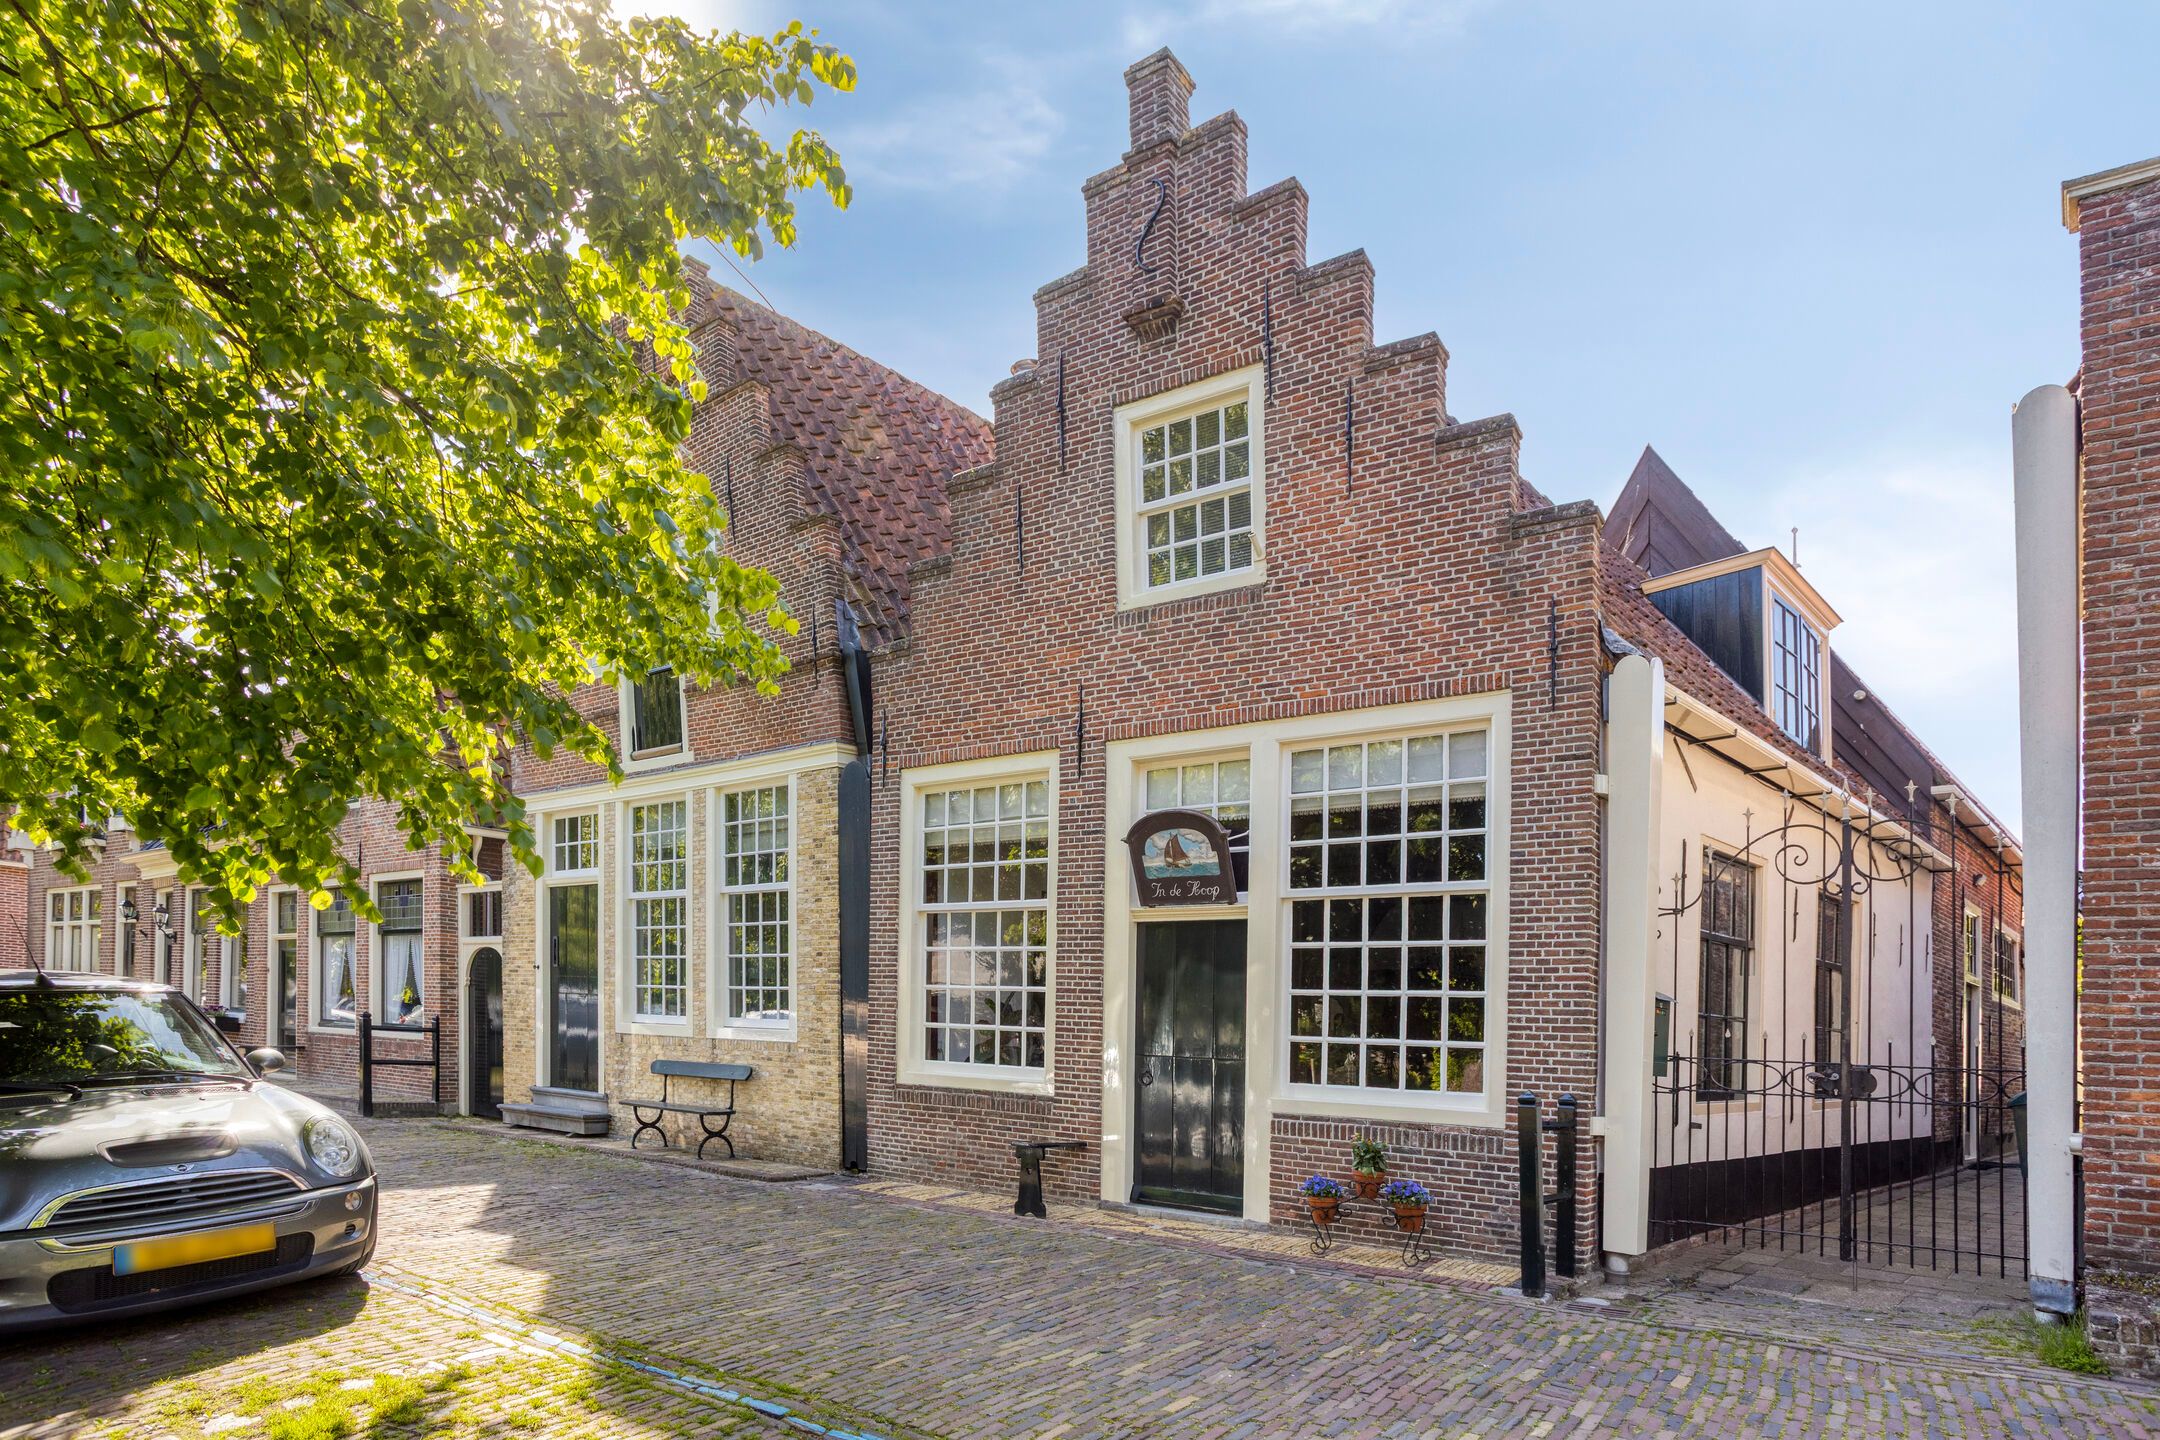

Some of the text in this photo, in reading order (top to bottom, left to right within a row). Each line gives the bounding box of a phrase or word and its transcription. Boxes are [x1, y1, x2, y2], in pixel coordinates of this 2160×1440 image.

[1151, 880, 1220, 901] In de Hoop
